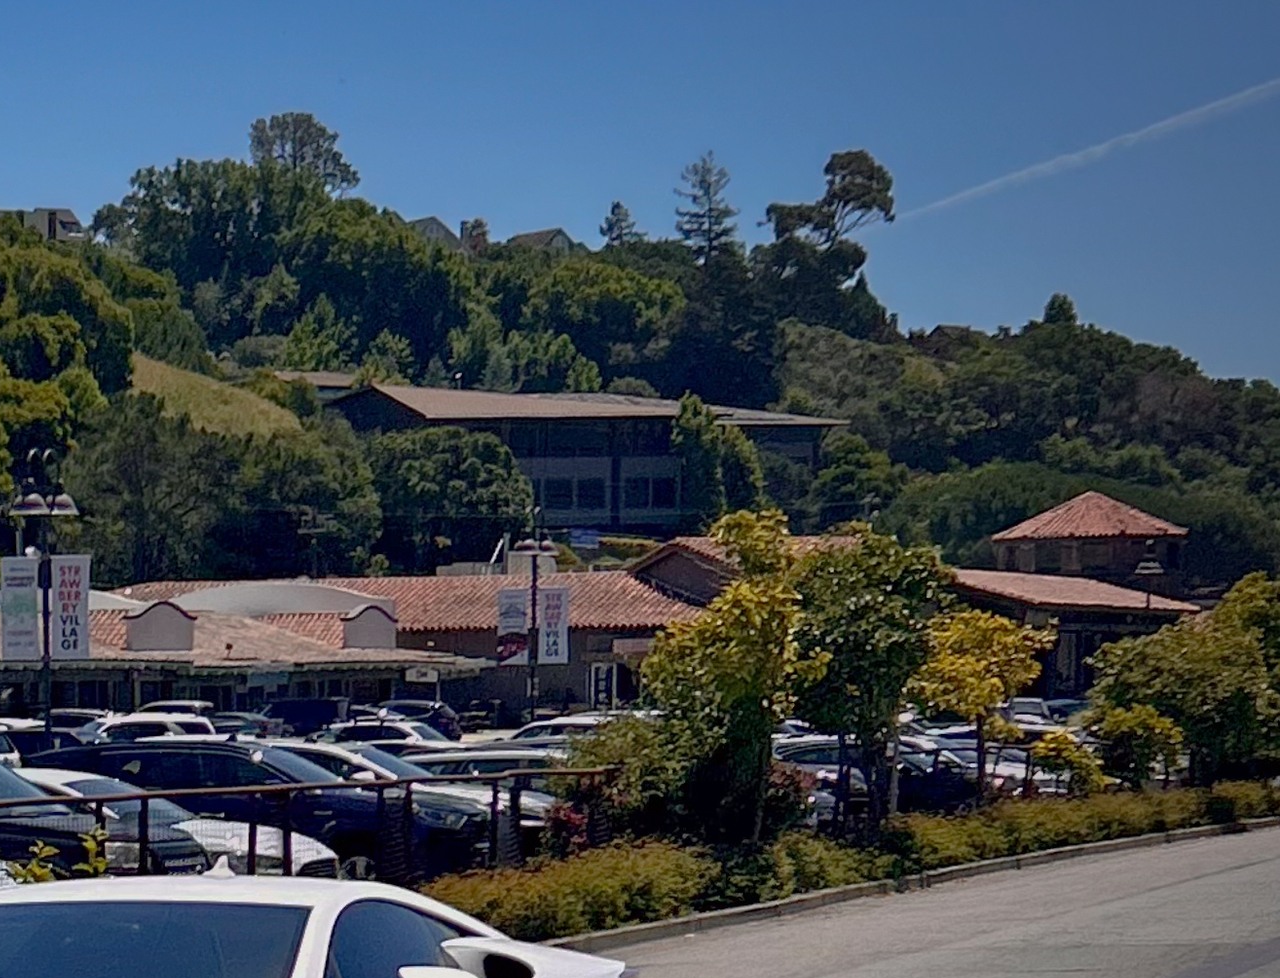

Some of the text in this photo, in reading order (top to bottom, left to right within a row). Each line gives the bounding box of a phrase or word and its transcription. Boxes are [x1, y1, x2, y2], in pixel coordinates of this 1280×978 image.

[59, 565, 81, 577] STR
[60, 579, 81, 589] AW
[62, 602, 78, 613] RY
[60, 615, 80, 626] VIL
[62, 627, 78, 638] LA
